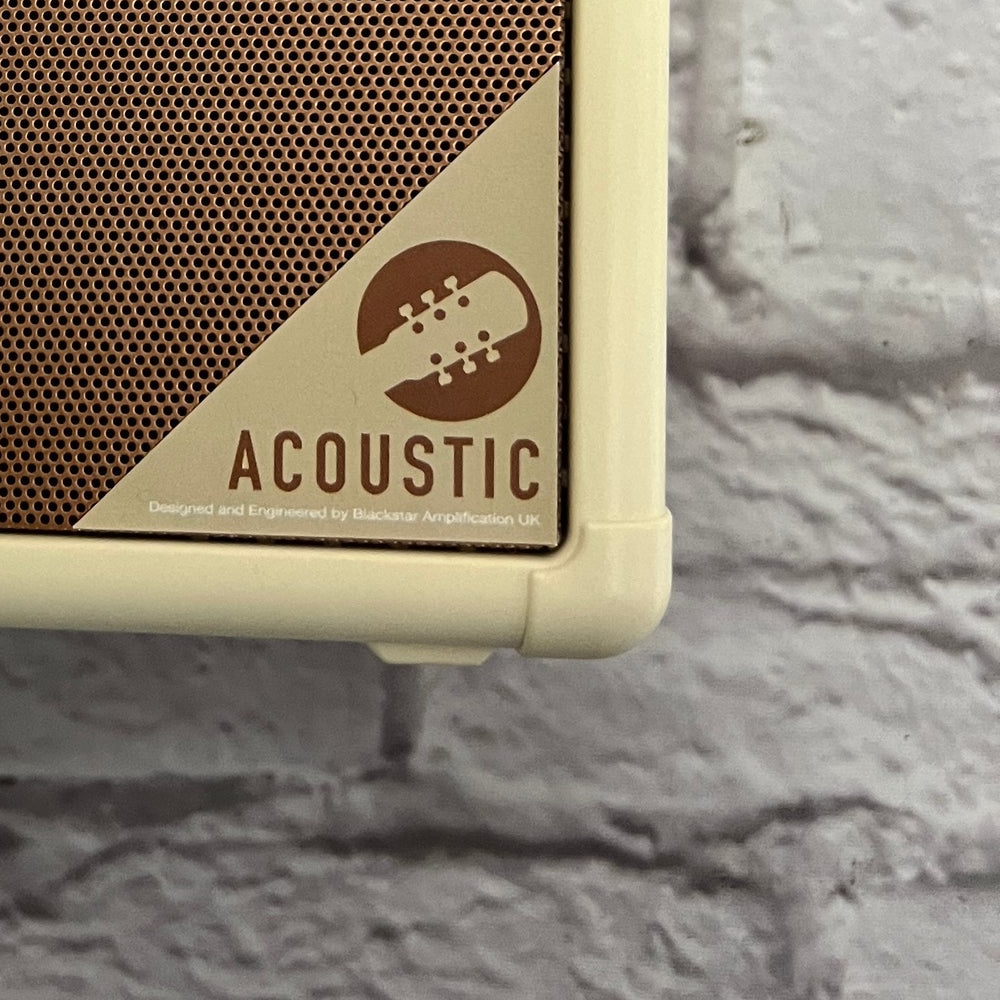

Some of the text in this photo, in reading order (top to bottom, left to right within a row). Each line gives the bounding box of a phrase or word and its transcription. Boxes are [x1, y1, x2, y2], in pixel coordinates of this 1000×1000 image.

[228, 429, 540, 501] ACOUSTIC
[149, 500, 541, 526] Designed and Engineered by Blackstar Amplification UK
